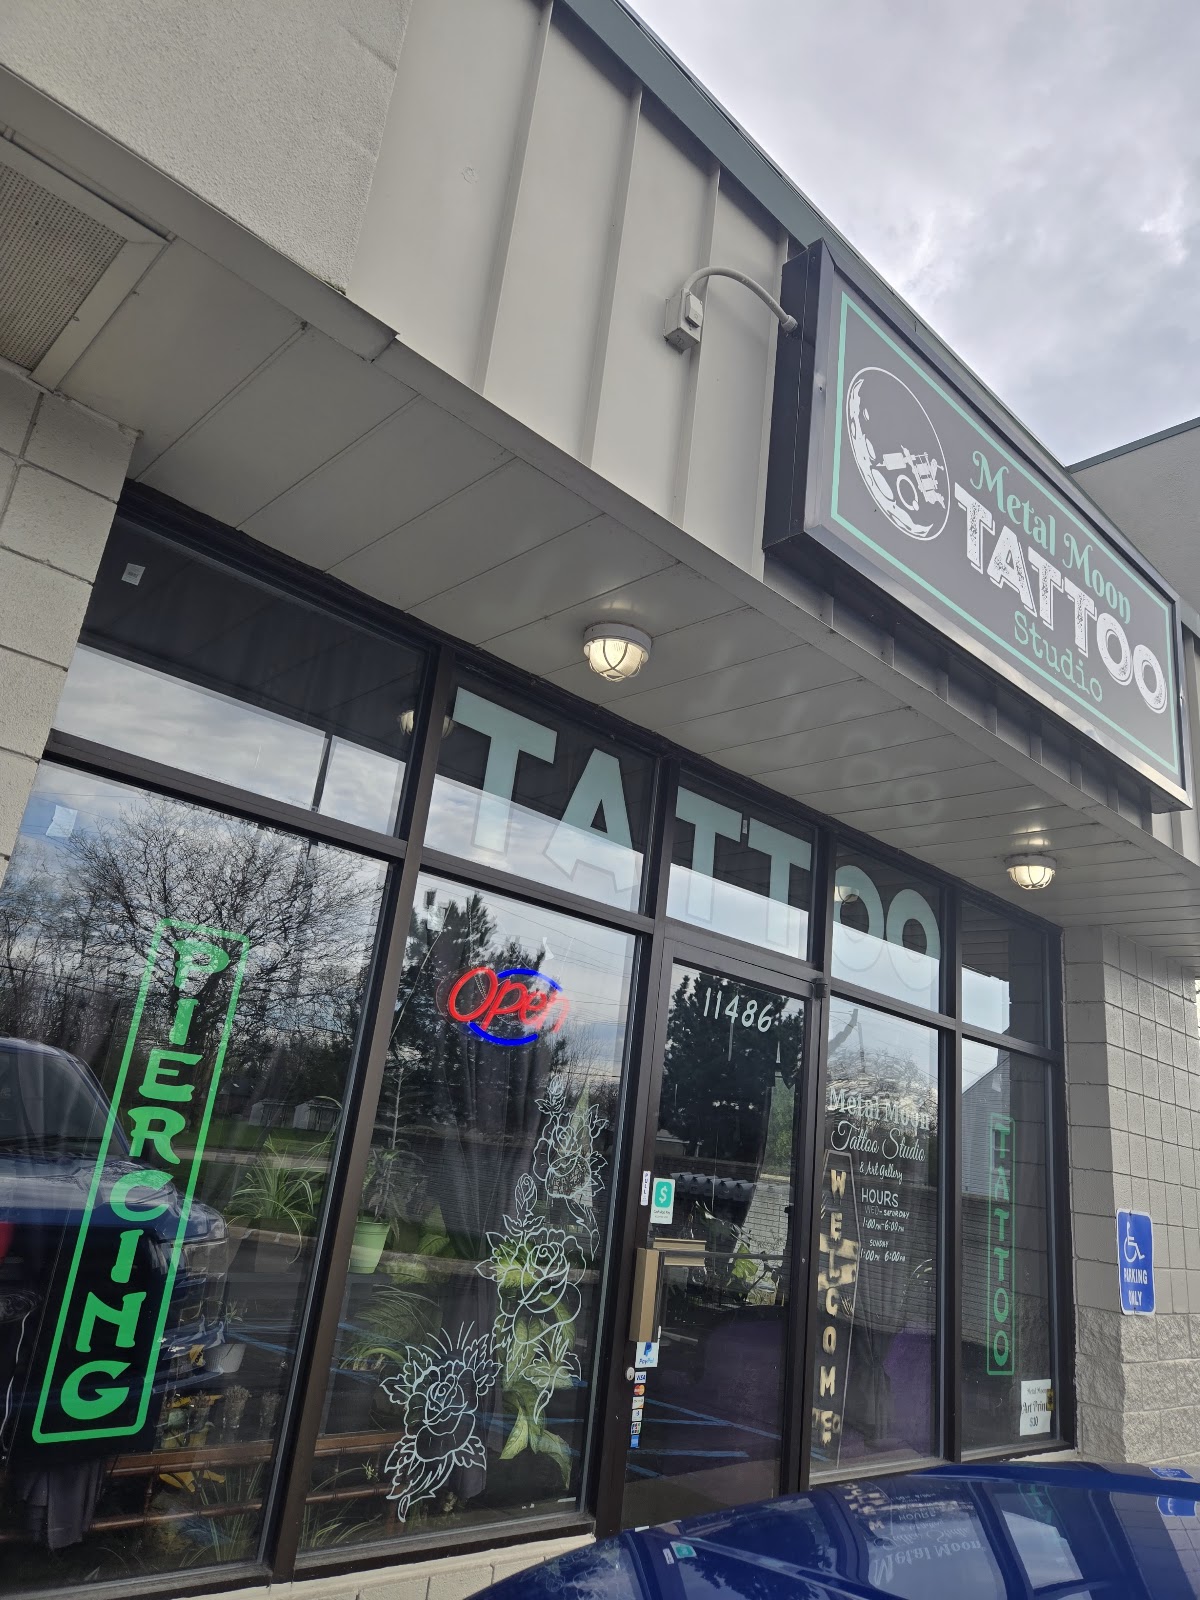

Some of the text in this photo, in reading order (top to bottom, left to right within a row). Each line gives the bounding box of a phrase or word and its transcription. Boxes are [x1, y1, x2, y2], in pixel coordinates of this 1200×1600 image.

[971, 450, 1131, 625] Metal Moon
[954, 482, 1168, 714] TATTOO
[1013, 609, 1103, 703] Studio
[452, 686, 941, 991] TATTOO
[703, 987, 773, 1033] 11486
[828, 1087, 930, 1131] Metal Moon
[831, 1120, 926, 1162] Tattoo Studio
[59, 937, 230, 1421] PIERCING
[859, 1161, 865, 1173] &
[865, 1161, 879, 1176] Art
[861, 1187, 899, 1208] HOURS
[992, 1123, 1011, 1367] TATTOO
[1123, 1267, 1148, 1285] PARKING
[819, 1169, 847, 1447] WELCOME
